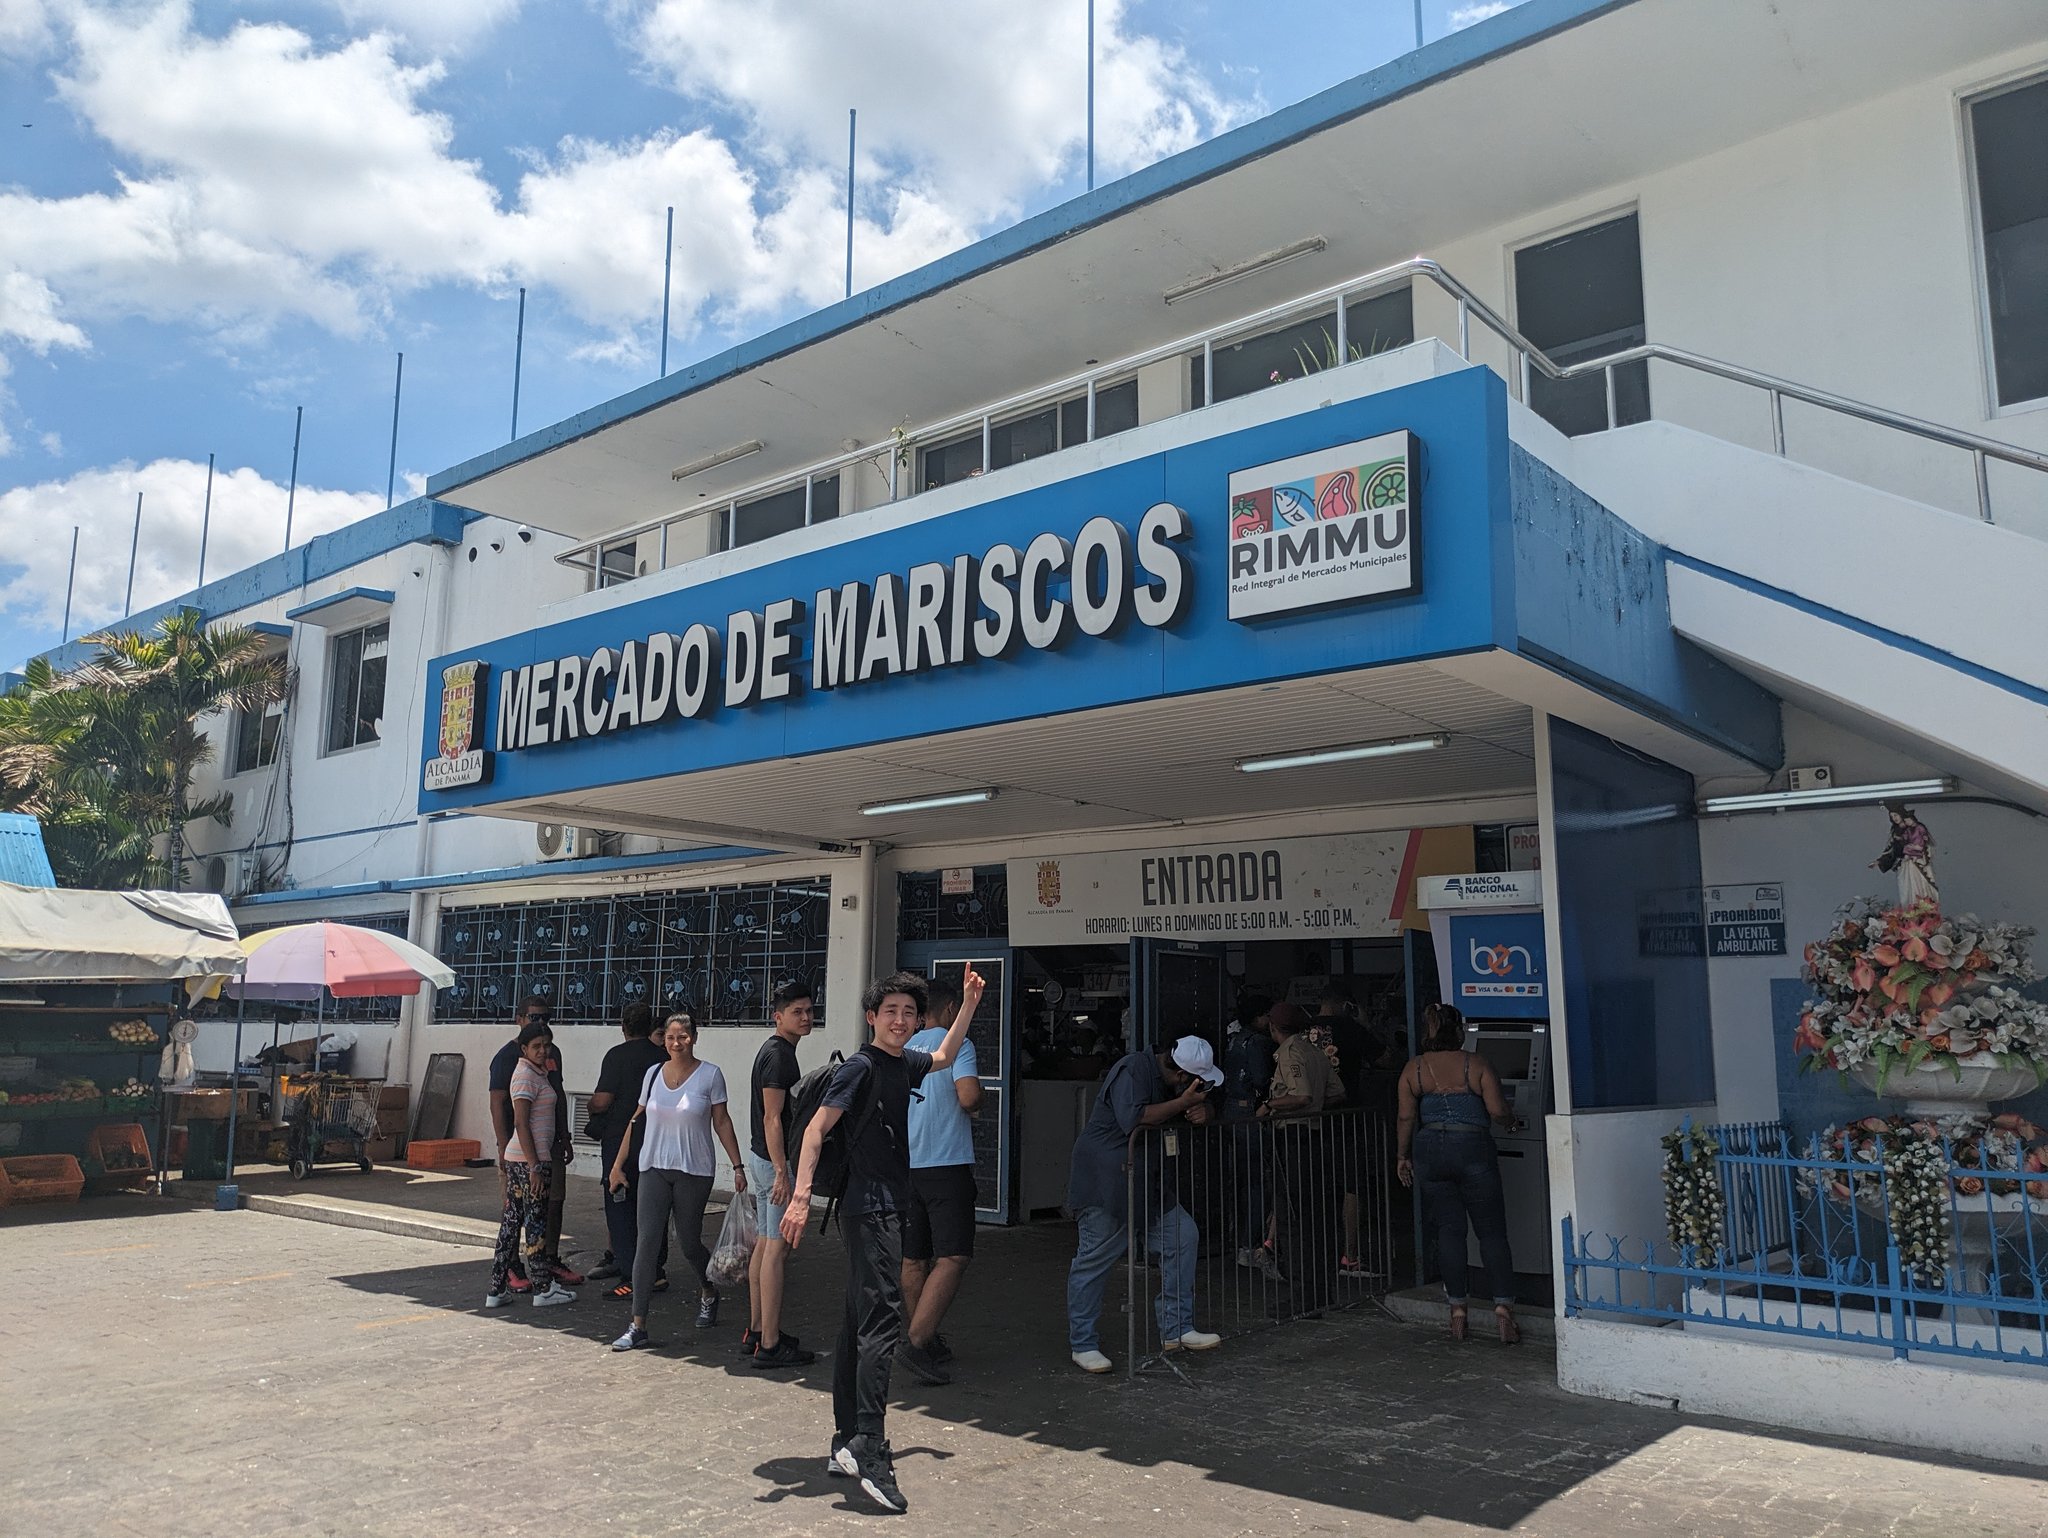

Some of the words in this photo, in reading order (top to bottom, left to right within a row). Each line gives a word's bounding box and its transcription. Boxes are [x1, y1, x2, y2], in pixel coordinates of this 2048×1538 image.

[1232, 509, 1407, 580] RIMMU
[1232, 582, 1249, 593] Red
[1251, 575, 1285, 588] Integral
[1287, 573, 1299, 582] de
[1302, 564, 1347, 579] Mercados
[1349, 553, 1407, 570] Municipales
[496, 623, 711, 752] MERCADO
[724, 598, 794, 707] DE
[812, 502, 1184, 690] MARISCOS
[426, 752, 482, 779] ALCALDÍA
[435, 776, 443, 786] DE
[445, 771, 471, 785] PANAMÁ
[1141, 850, 1283, 906] ENTRADA
[1465, 876, 1501, 885] BANCO
[1465, 884, 1519, 893] NACIONAL
[1085, 917, 1130, 934] HORARIO:
[1132, 916, 1162, 933] LUNES
[1165, 915, 1172, 932] A
[1174, 913, 1222, 931] DOMINGO
[1224, 912, 1238, 930] DE
[1241, 911, 1265, 929] 5:00
[1269, 911, 1293, 929] A.M.
[1303, 909, 1330, 927] 5:00
[1333, 907, 1356, 926] P.M.
[1710, 908, 1781, 923] ¡PROHIBIDO!
[1723, 927, 1736, 939] LA
[1737, 926, 1771, 939] VENTA
[1716, 939, 1778, 953] AMBULANTE
